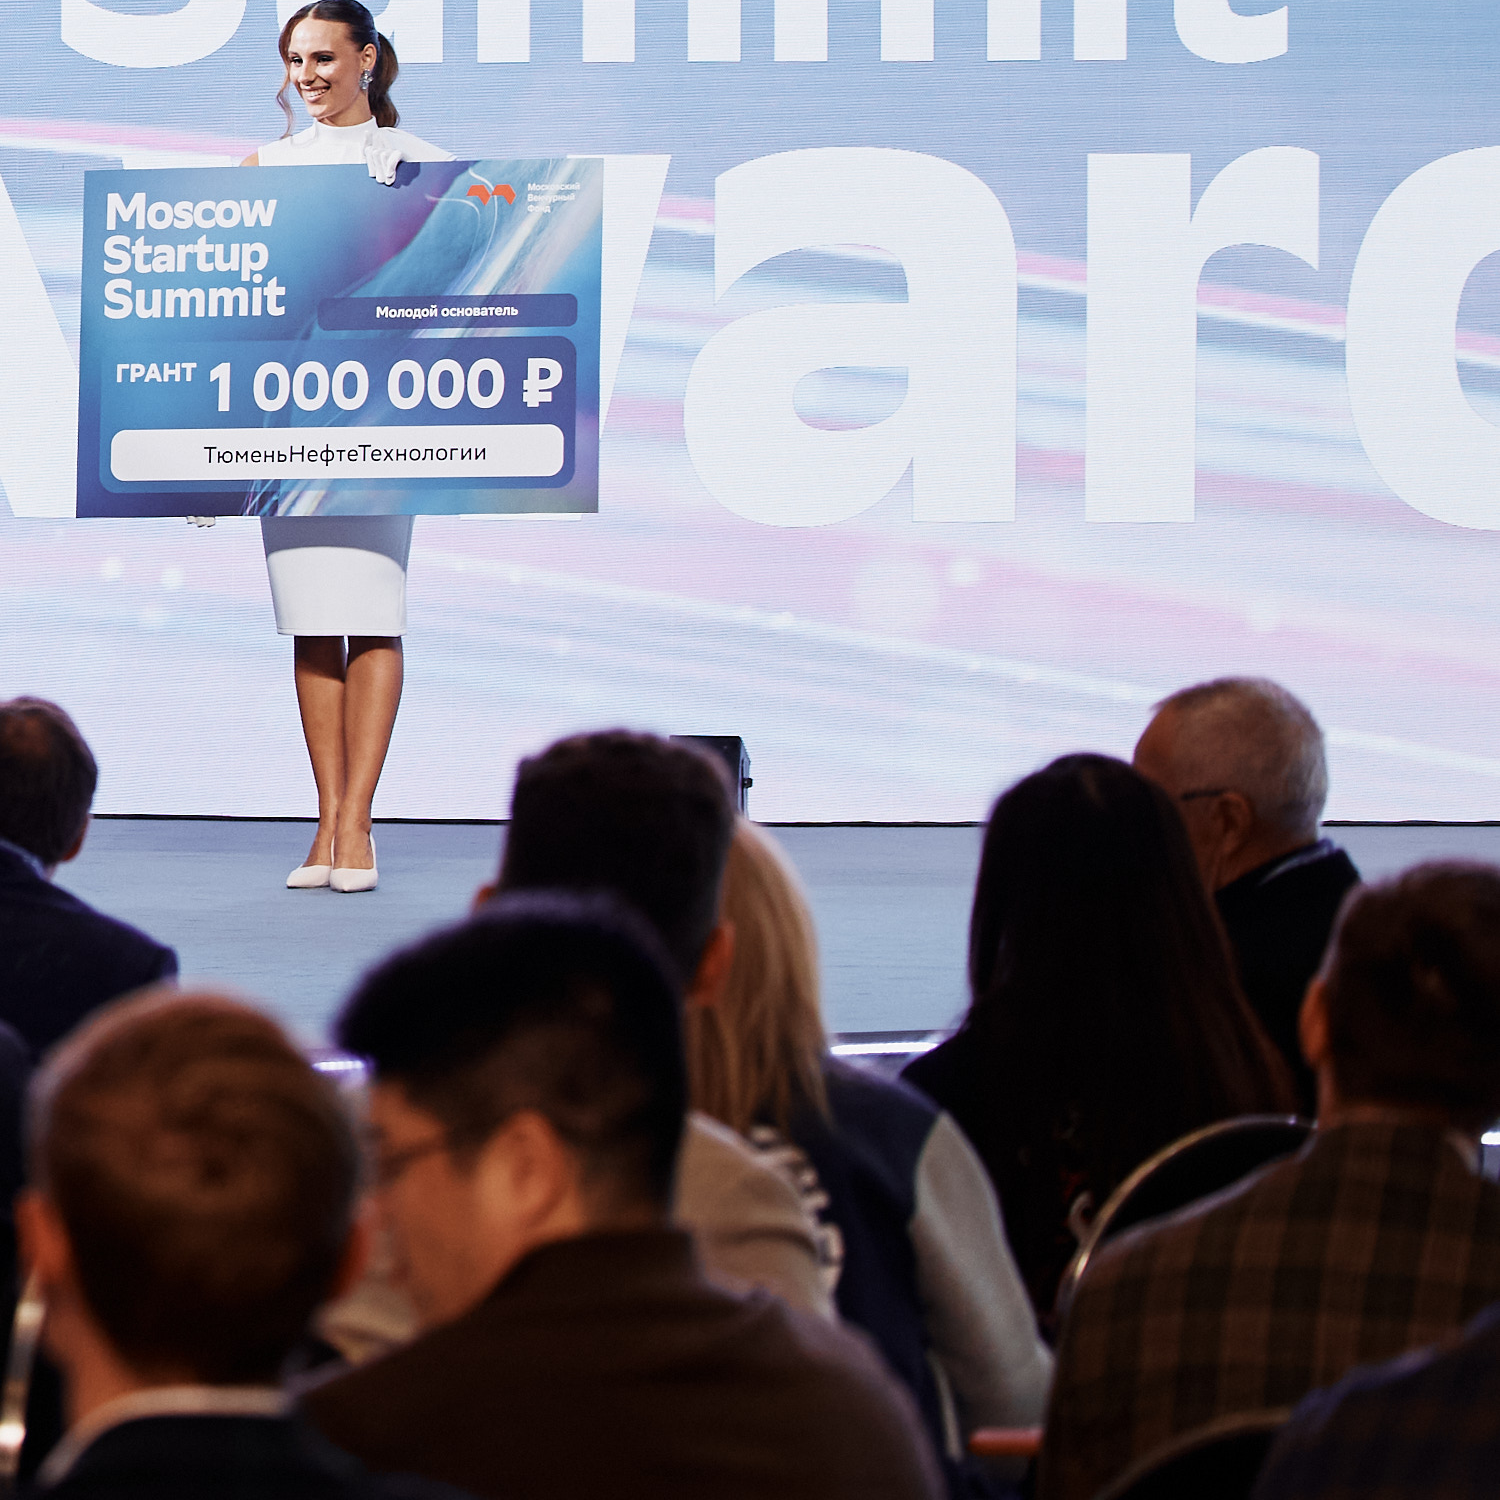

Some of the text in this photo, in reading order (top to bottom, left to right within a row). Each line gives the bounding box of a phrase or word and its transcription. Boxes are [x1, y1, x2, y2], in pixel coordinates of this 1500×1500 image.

[106, 192, 278, 230] Moscow
[103, 234, 269, 281] Startup
[103, 273, 286, 319] Summit
[375, 304, 519, 320] Молодой основатель
[116, 362, 197, 383] ГРАНТ
[209, 362, 231, 412] 1
[253, 360, 369, 412] 000
[387, 358, 505, 410] 000
[203, 444, 486, 467] ТюменьНефтеТехнологии
